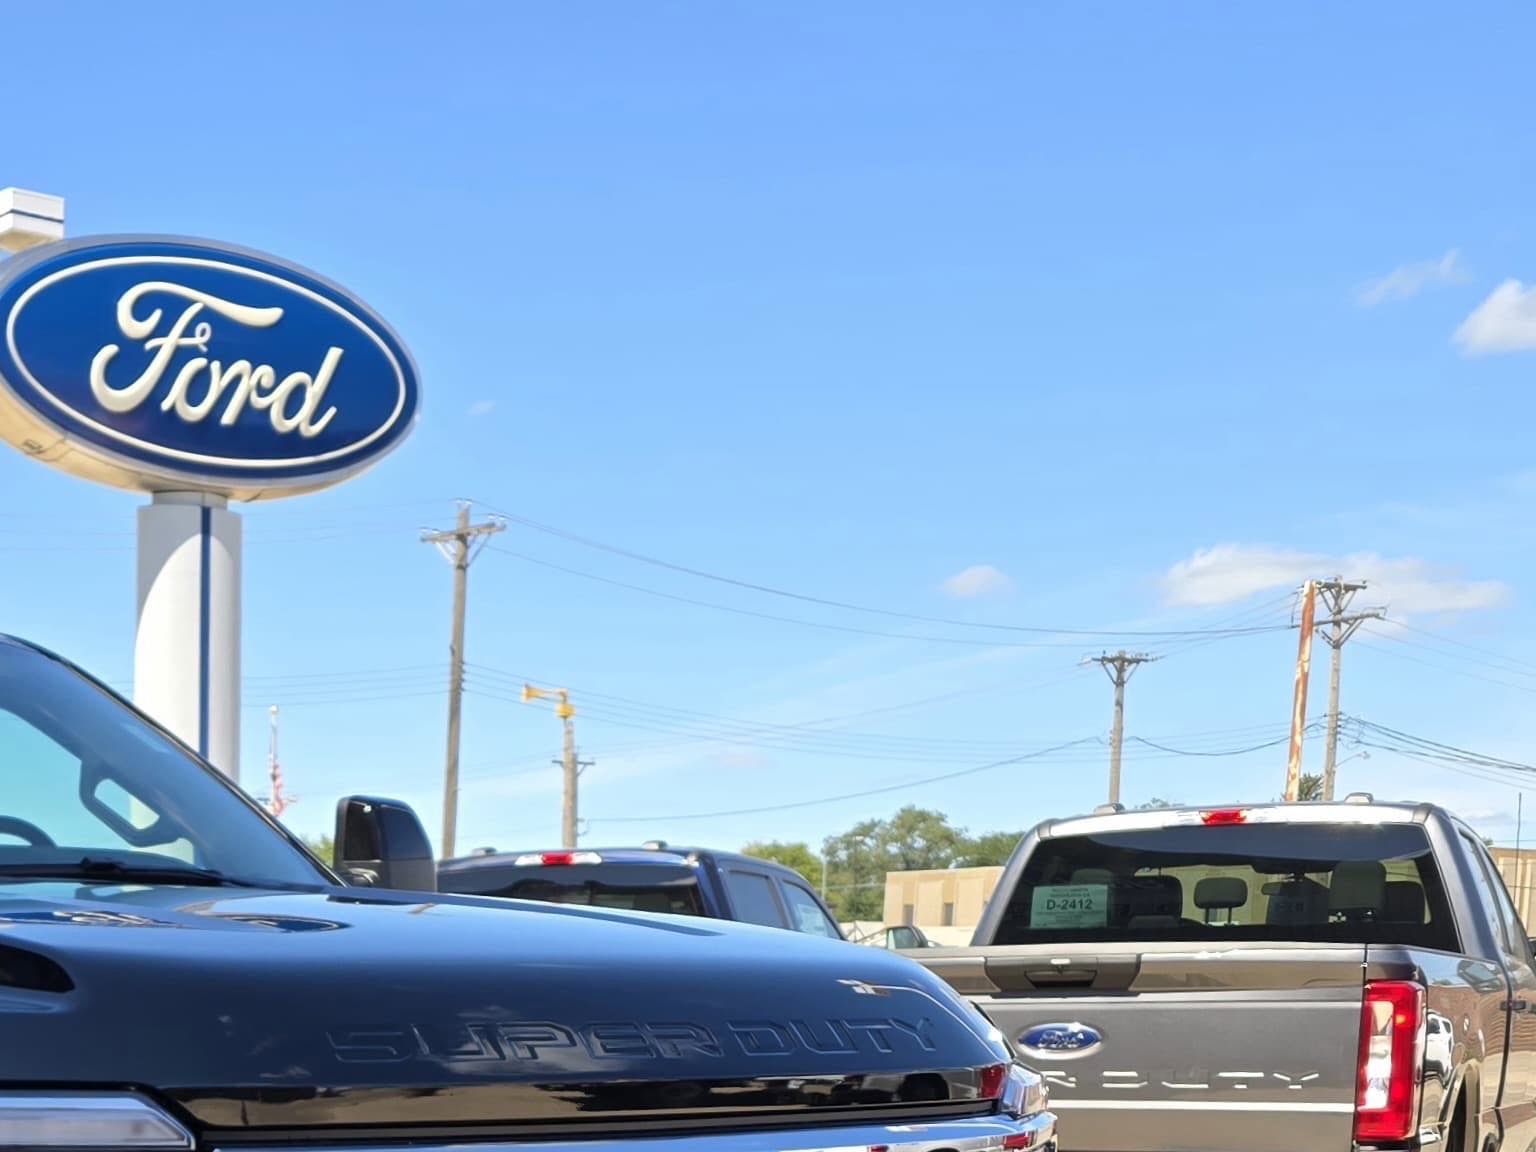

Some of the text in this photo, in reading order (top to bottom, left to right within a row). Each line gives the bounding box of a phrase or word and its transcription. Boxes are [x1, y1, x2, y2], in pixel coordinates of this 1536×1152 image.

[89, 280, 344, 438] Ford
[1046, 898, 1093, 911] D-2412
[325, 1016, 938, 1064] SUPER DUTY
[1102, 1070, 1320, 1090] DUTY
